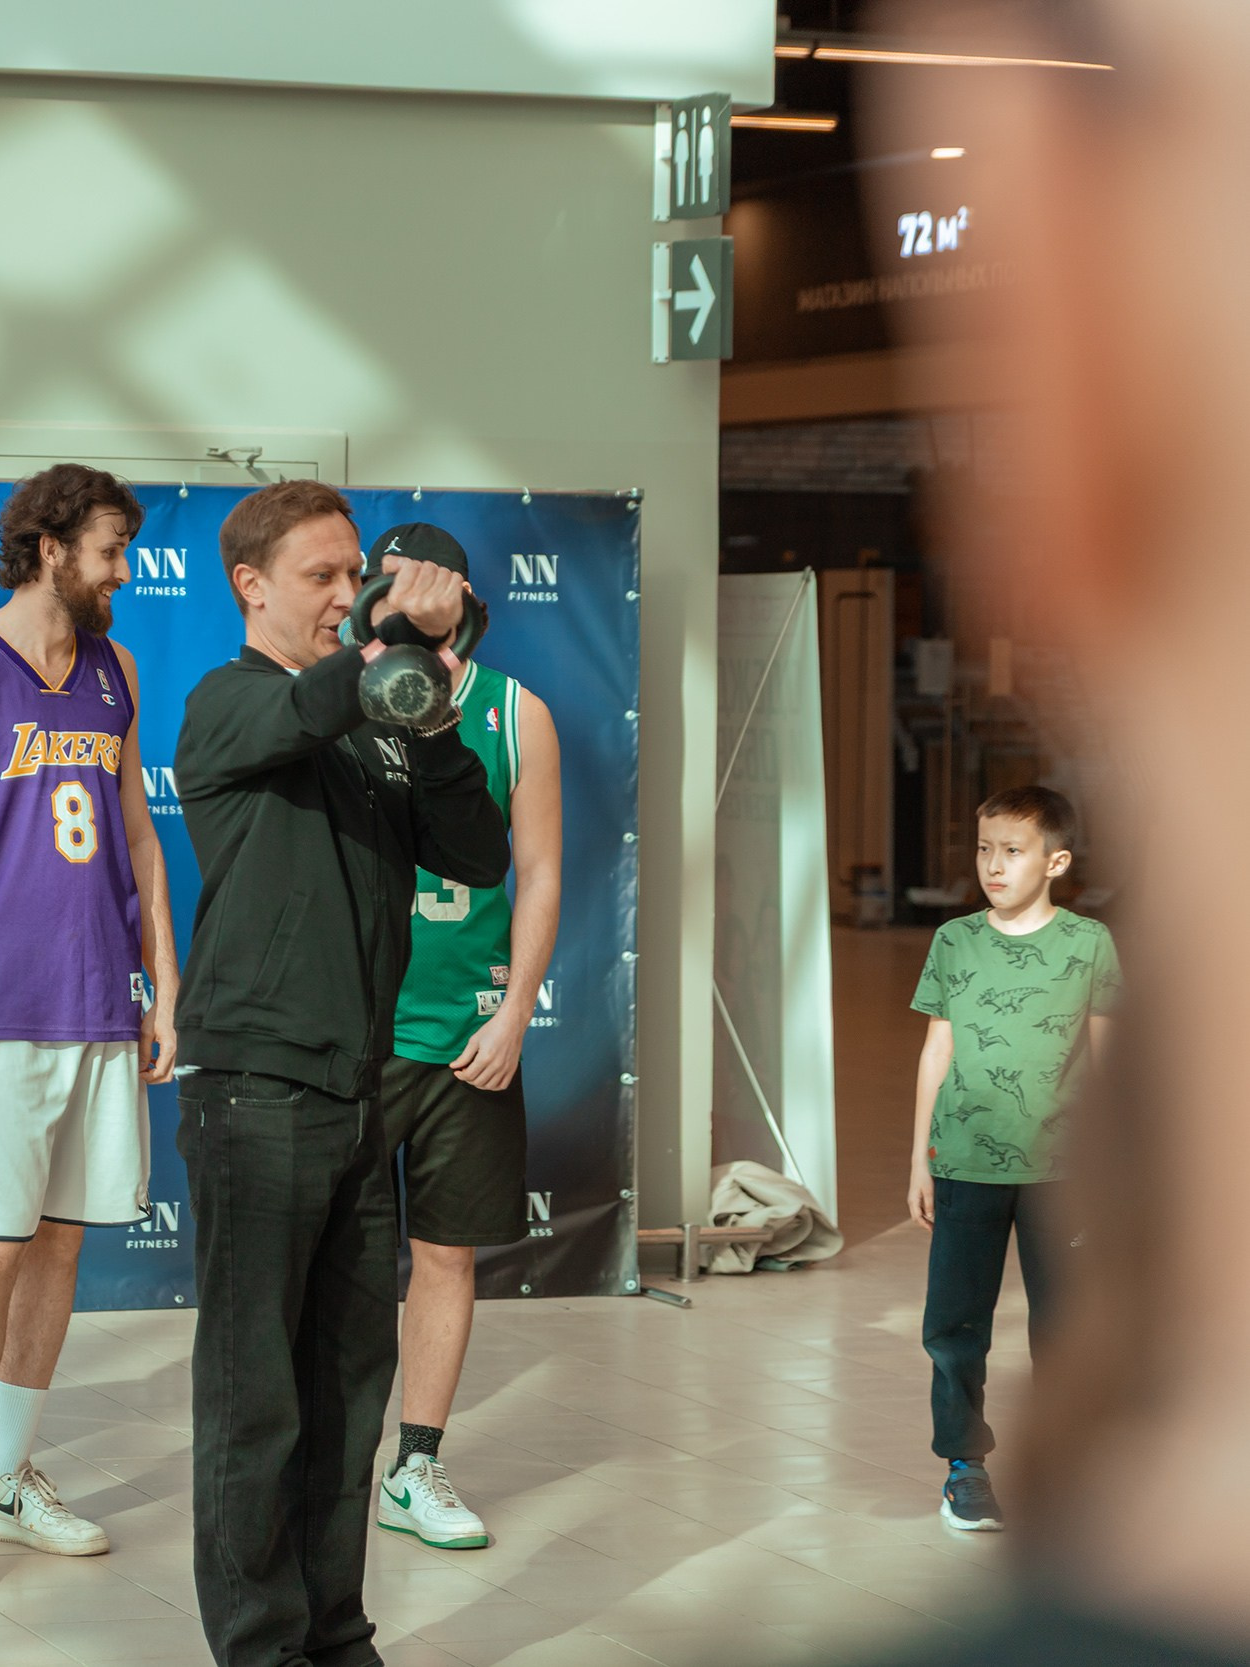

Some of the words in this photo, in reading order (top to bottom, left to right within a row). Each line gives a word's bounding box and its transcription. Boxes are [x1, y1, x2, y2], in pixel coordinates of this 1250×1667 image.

[898, 211, 932, 258] 72
[136, 547, 188, 579] NN
[510, 553, 559, 586] NN
[135, 586, 187, 596] FITNESS
[508, 591, 559, 602] FITNESS
[0, 722, 123, 780] LAKERS
[50, 780, 99, 863] 8
[125, 1239, 179, 1249] FITNESS
